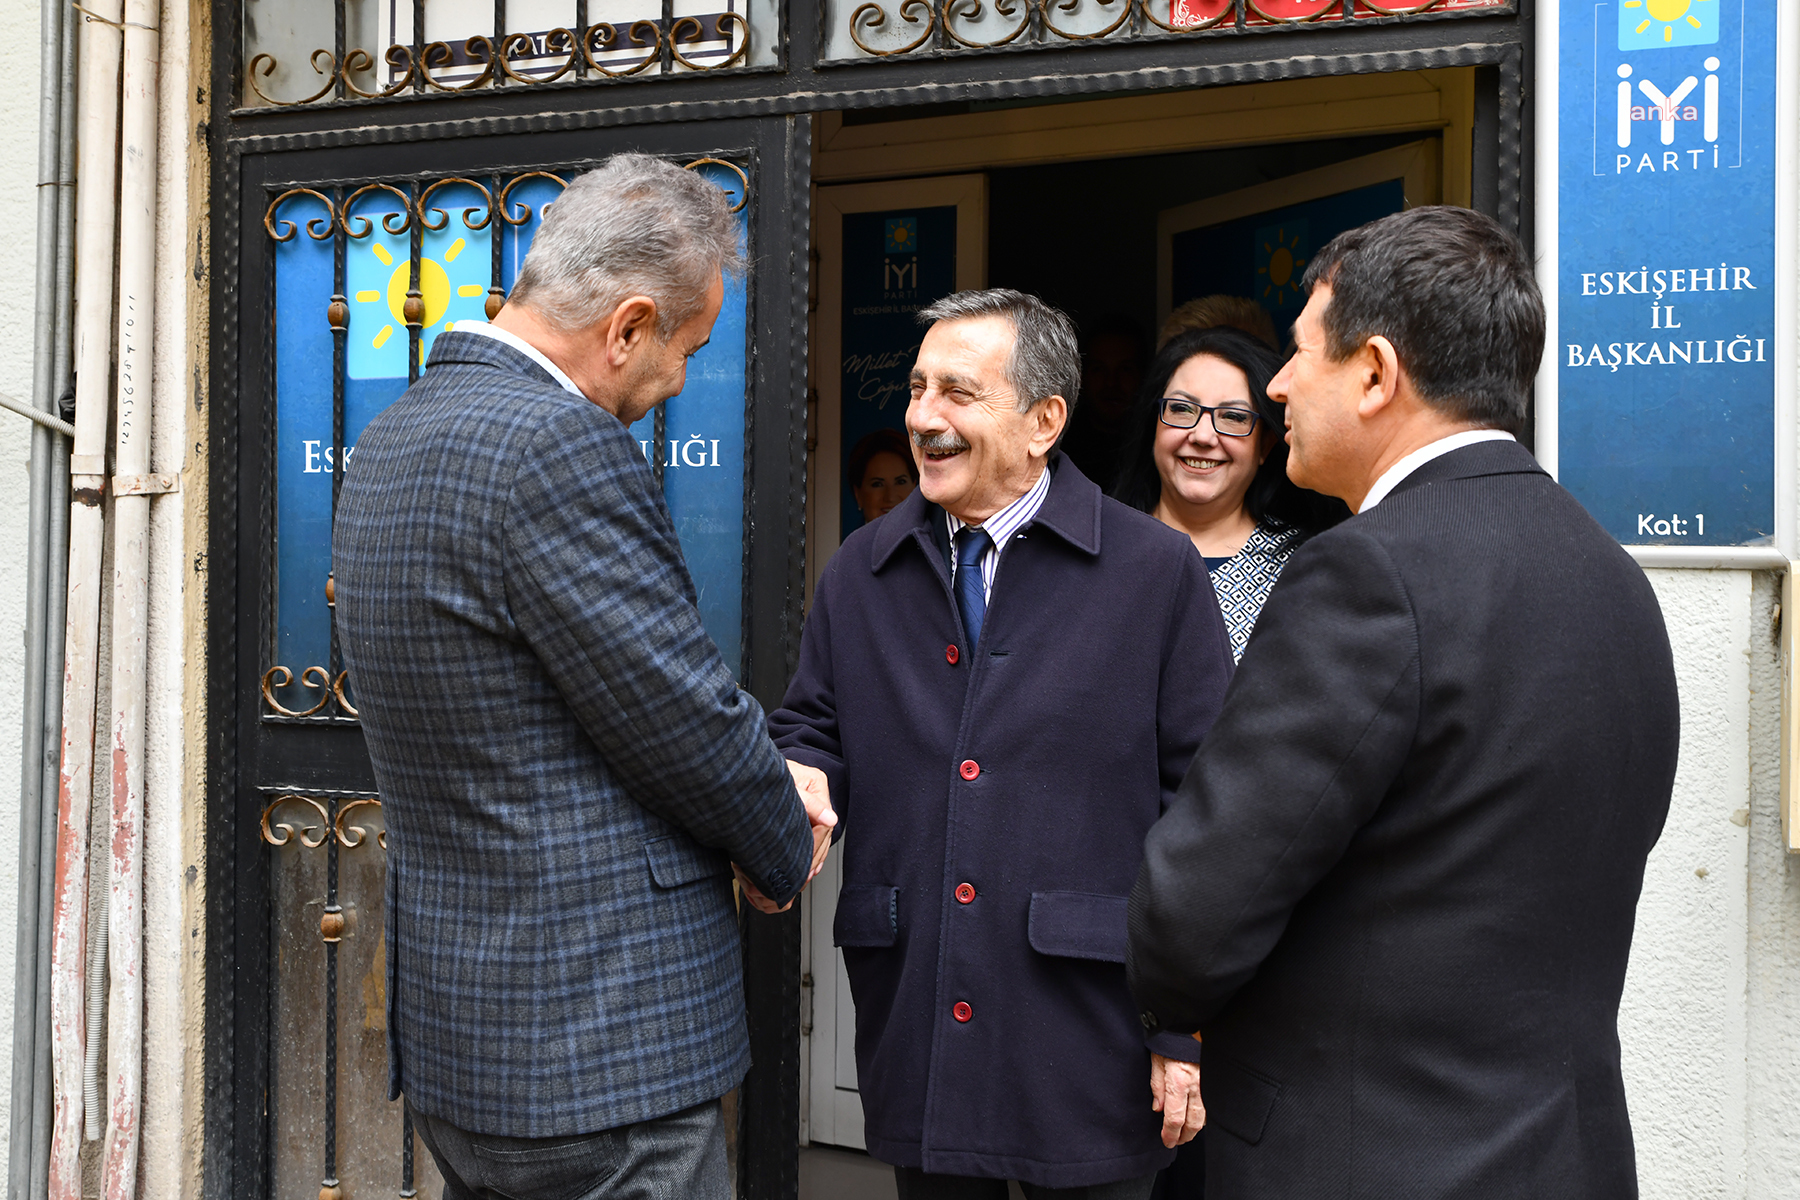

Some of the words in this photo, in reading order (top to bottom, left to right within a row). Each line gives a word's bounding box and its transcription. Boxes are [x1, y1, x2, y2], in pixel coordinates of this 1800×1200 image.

[1617, 144, 1719, 174] PARTİ
[884, 289, 917, 300] PARTİ
[1581, 262, 1757, 299] ESKİŞEHİR
[1650, 301, 1681, 329] İL
[843, 350, 909, 382] Millet
[1567, 334, 1766, 372] BAŞKANLIĞI
[1638, 514, 1687, 535] Kat:
[1695, 514, 1704, 535] 1
